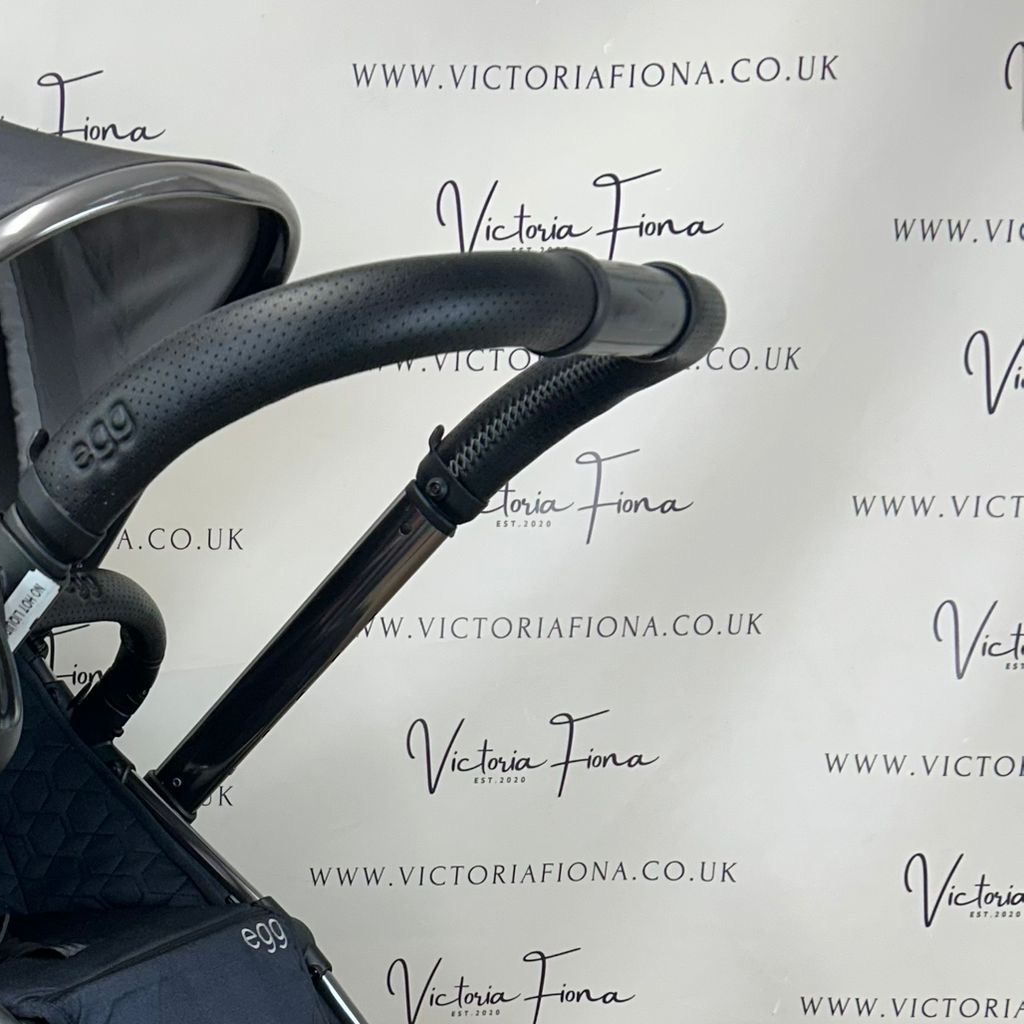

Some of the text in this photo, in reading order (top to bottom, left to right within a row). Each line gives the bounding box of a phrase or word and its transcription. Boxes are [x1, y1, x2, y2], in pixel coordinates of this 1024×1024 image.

[351, 54, 840, 91] WWW.VICTORIAFIONA.CO.UK
[436, 168, 725, 262] Victoria Fiona
[893, 217, 1024, 244] WWW.VI
[73, 399, 136, 470] egg
[576, 449, 695, 544] Fiona
[360, 613, 763, 640] WW.VICTORIAFIONA.CO.UK
[405, 709, 660, 798] Victoria Fiona
[473, 775, 526, 785] EST.2020
[309, 859, 738, 887] WWW.VICTORIAFIONA.CO.UK
[969, 910, 1022, 919] EST.2020
[241, 918, 288, 953] egg
[451, 1008, 501, 1018] EST.2020
